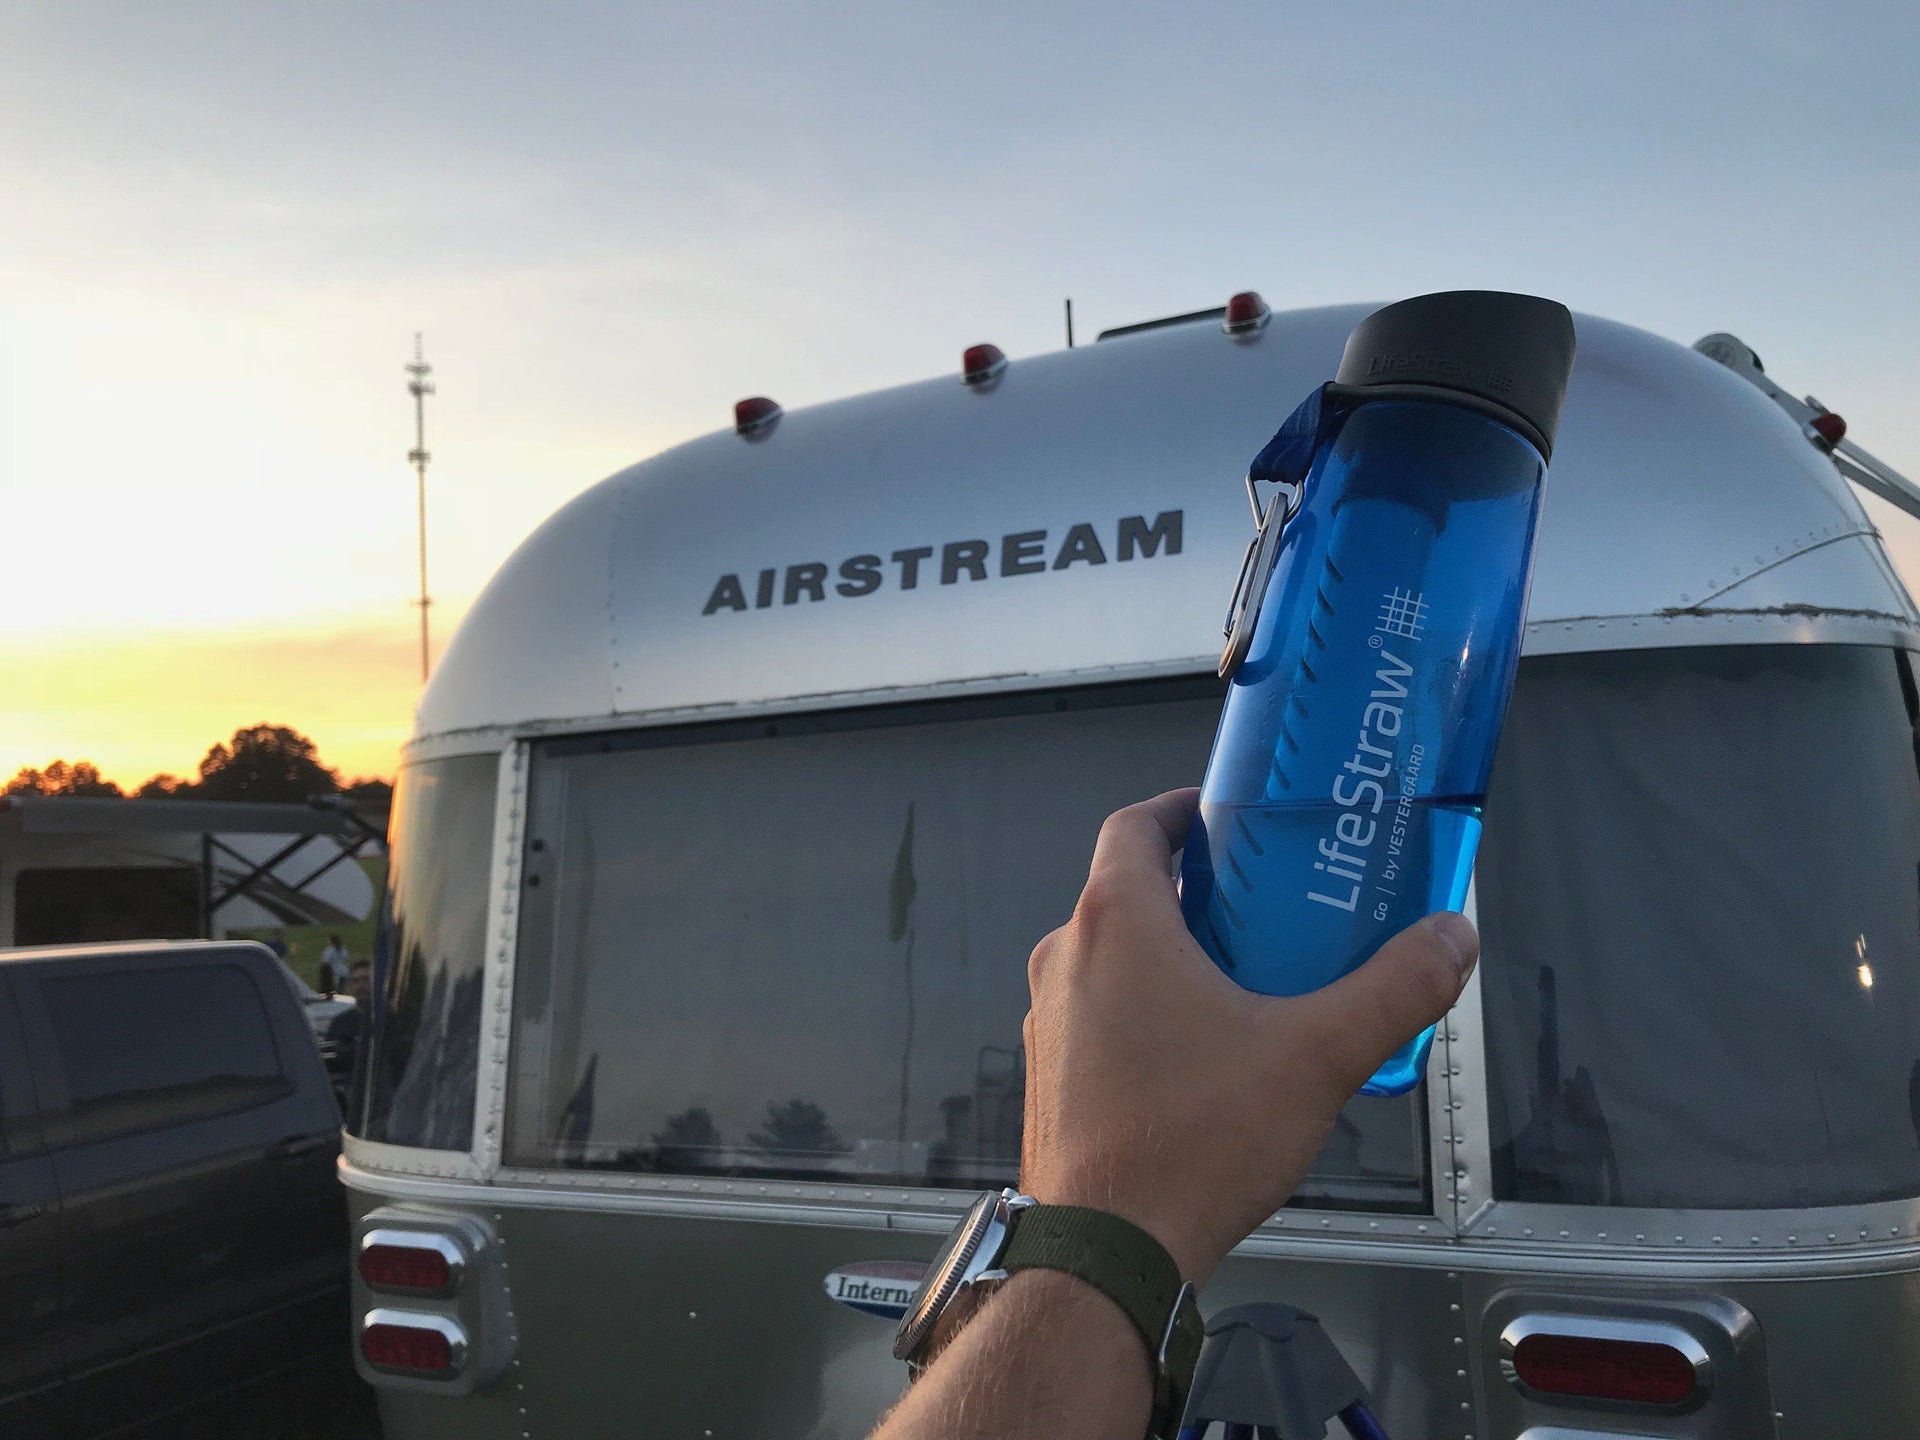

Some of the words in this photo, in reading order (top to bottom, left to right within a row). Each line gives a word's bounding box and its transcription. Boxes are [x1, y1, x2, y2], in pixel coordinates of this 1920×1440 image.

[701, 509, 1184, 616] AIRSTREAM
[1386, 743, 1425, 857] VESTERGAARD
[1383, 850, 1401, 881] by
[1373, 902, 1389, 922] Go
